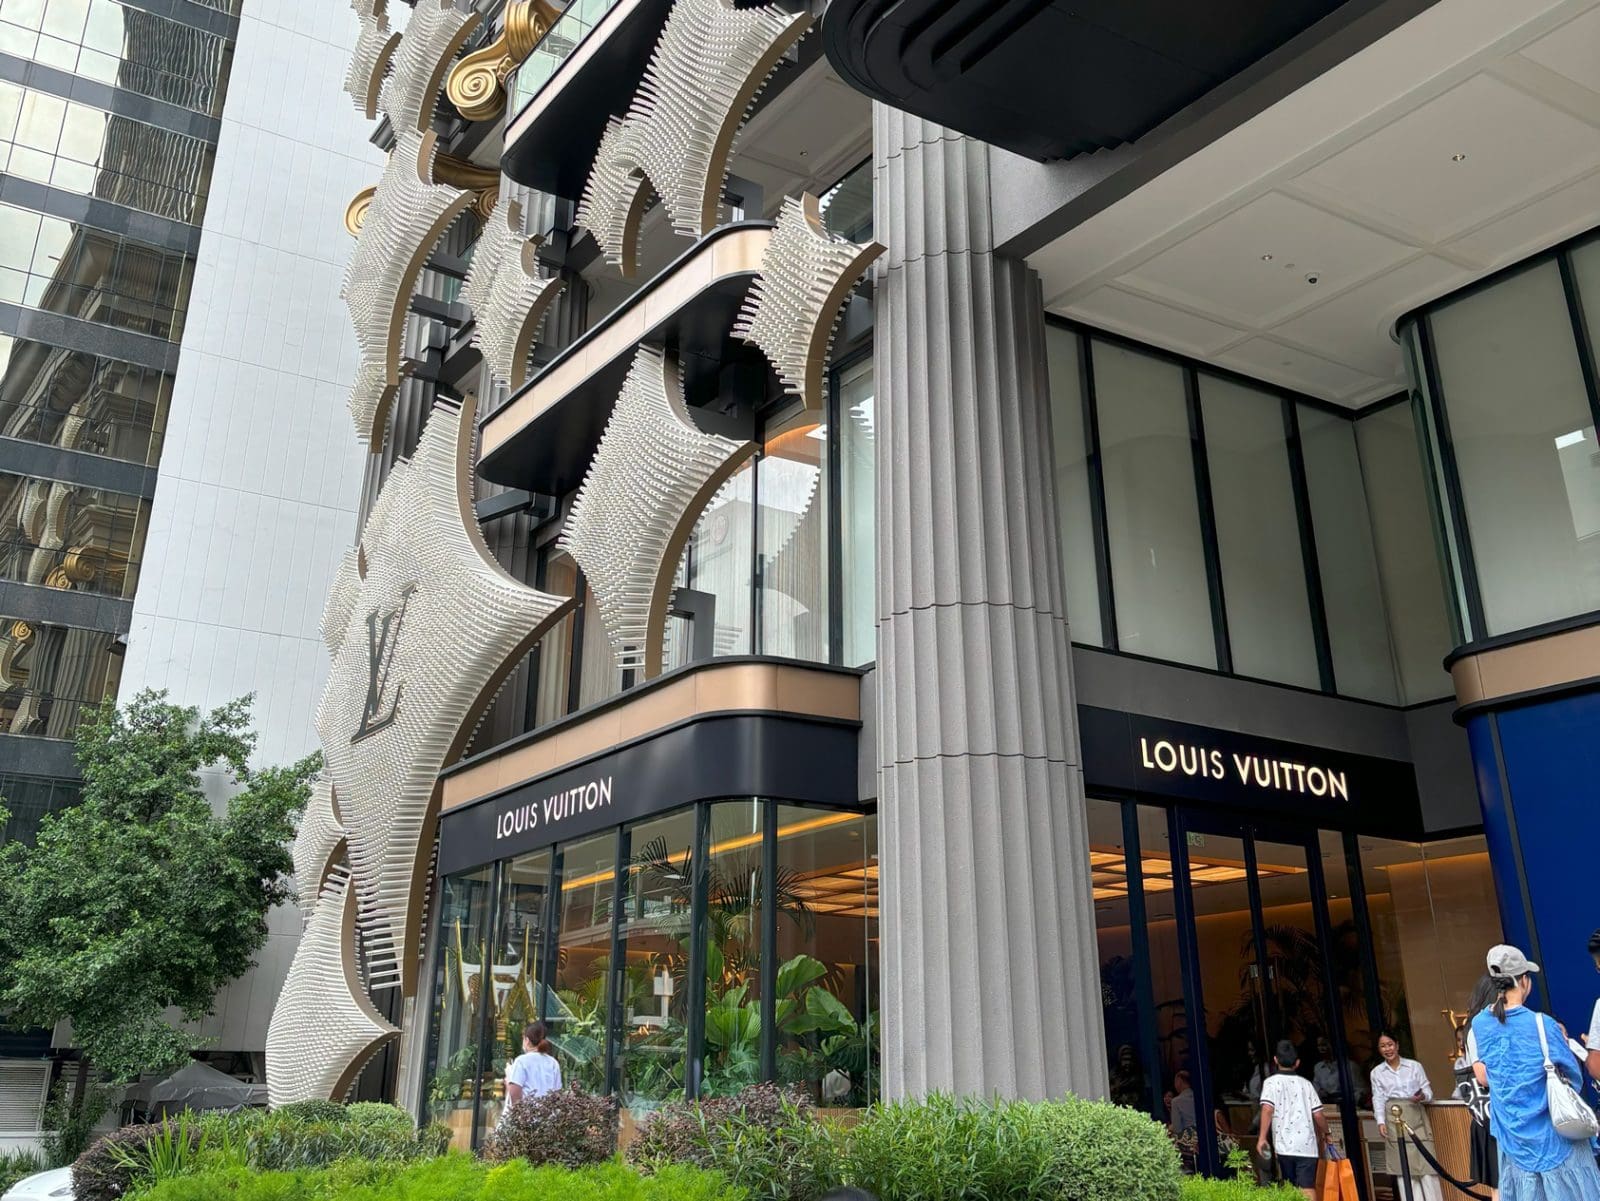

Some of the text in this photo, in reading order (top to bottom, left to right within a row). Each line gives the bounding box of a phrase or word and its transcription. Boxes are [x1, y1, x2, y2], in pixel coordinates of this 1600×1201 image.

[350, 581, 416, 744] LV
[1141, 738, 1349, 802] LOUIS VUITTON
[496, 776, 613, 839] LOUIS VUITTON
